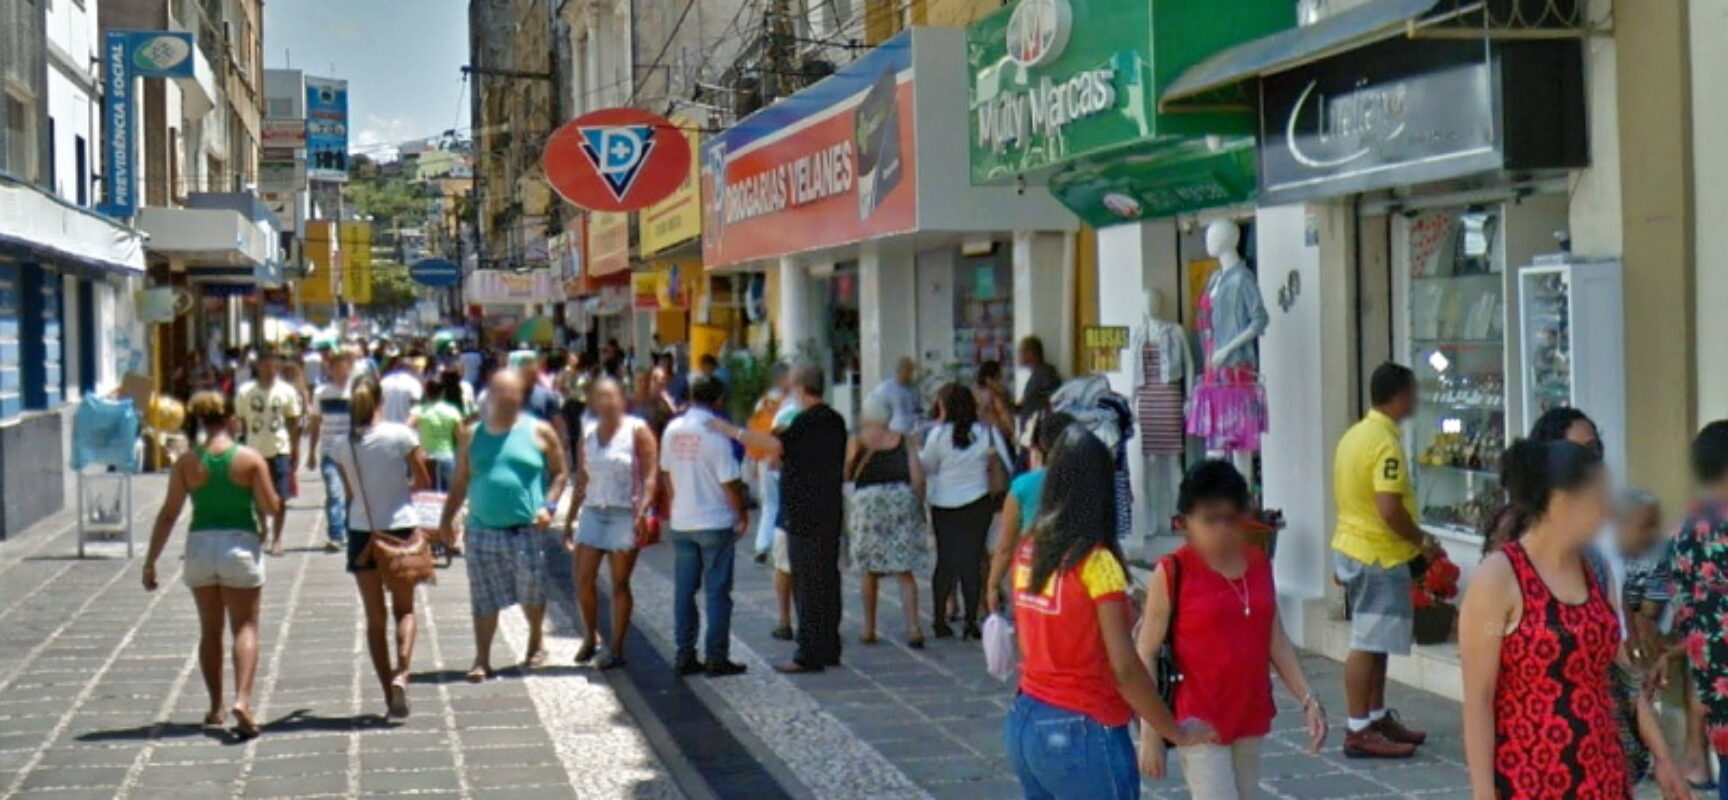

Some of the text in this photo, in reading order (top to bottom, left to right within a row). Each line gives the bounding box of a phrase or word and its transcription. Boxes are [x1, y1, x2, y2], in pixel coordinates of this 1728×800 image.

[111, 43, 128, 206] PREVIDÊNCIA SOCIAL
[1028, 70, 1116, 138] Marcas
[599, 128, 642, 174] D
[725, 140, 852, 224] DROGARIAS VELANES
[1383, 457, 1399, 480] 2
